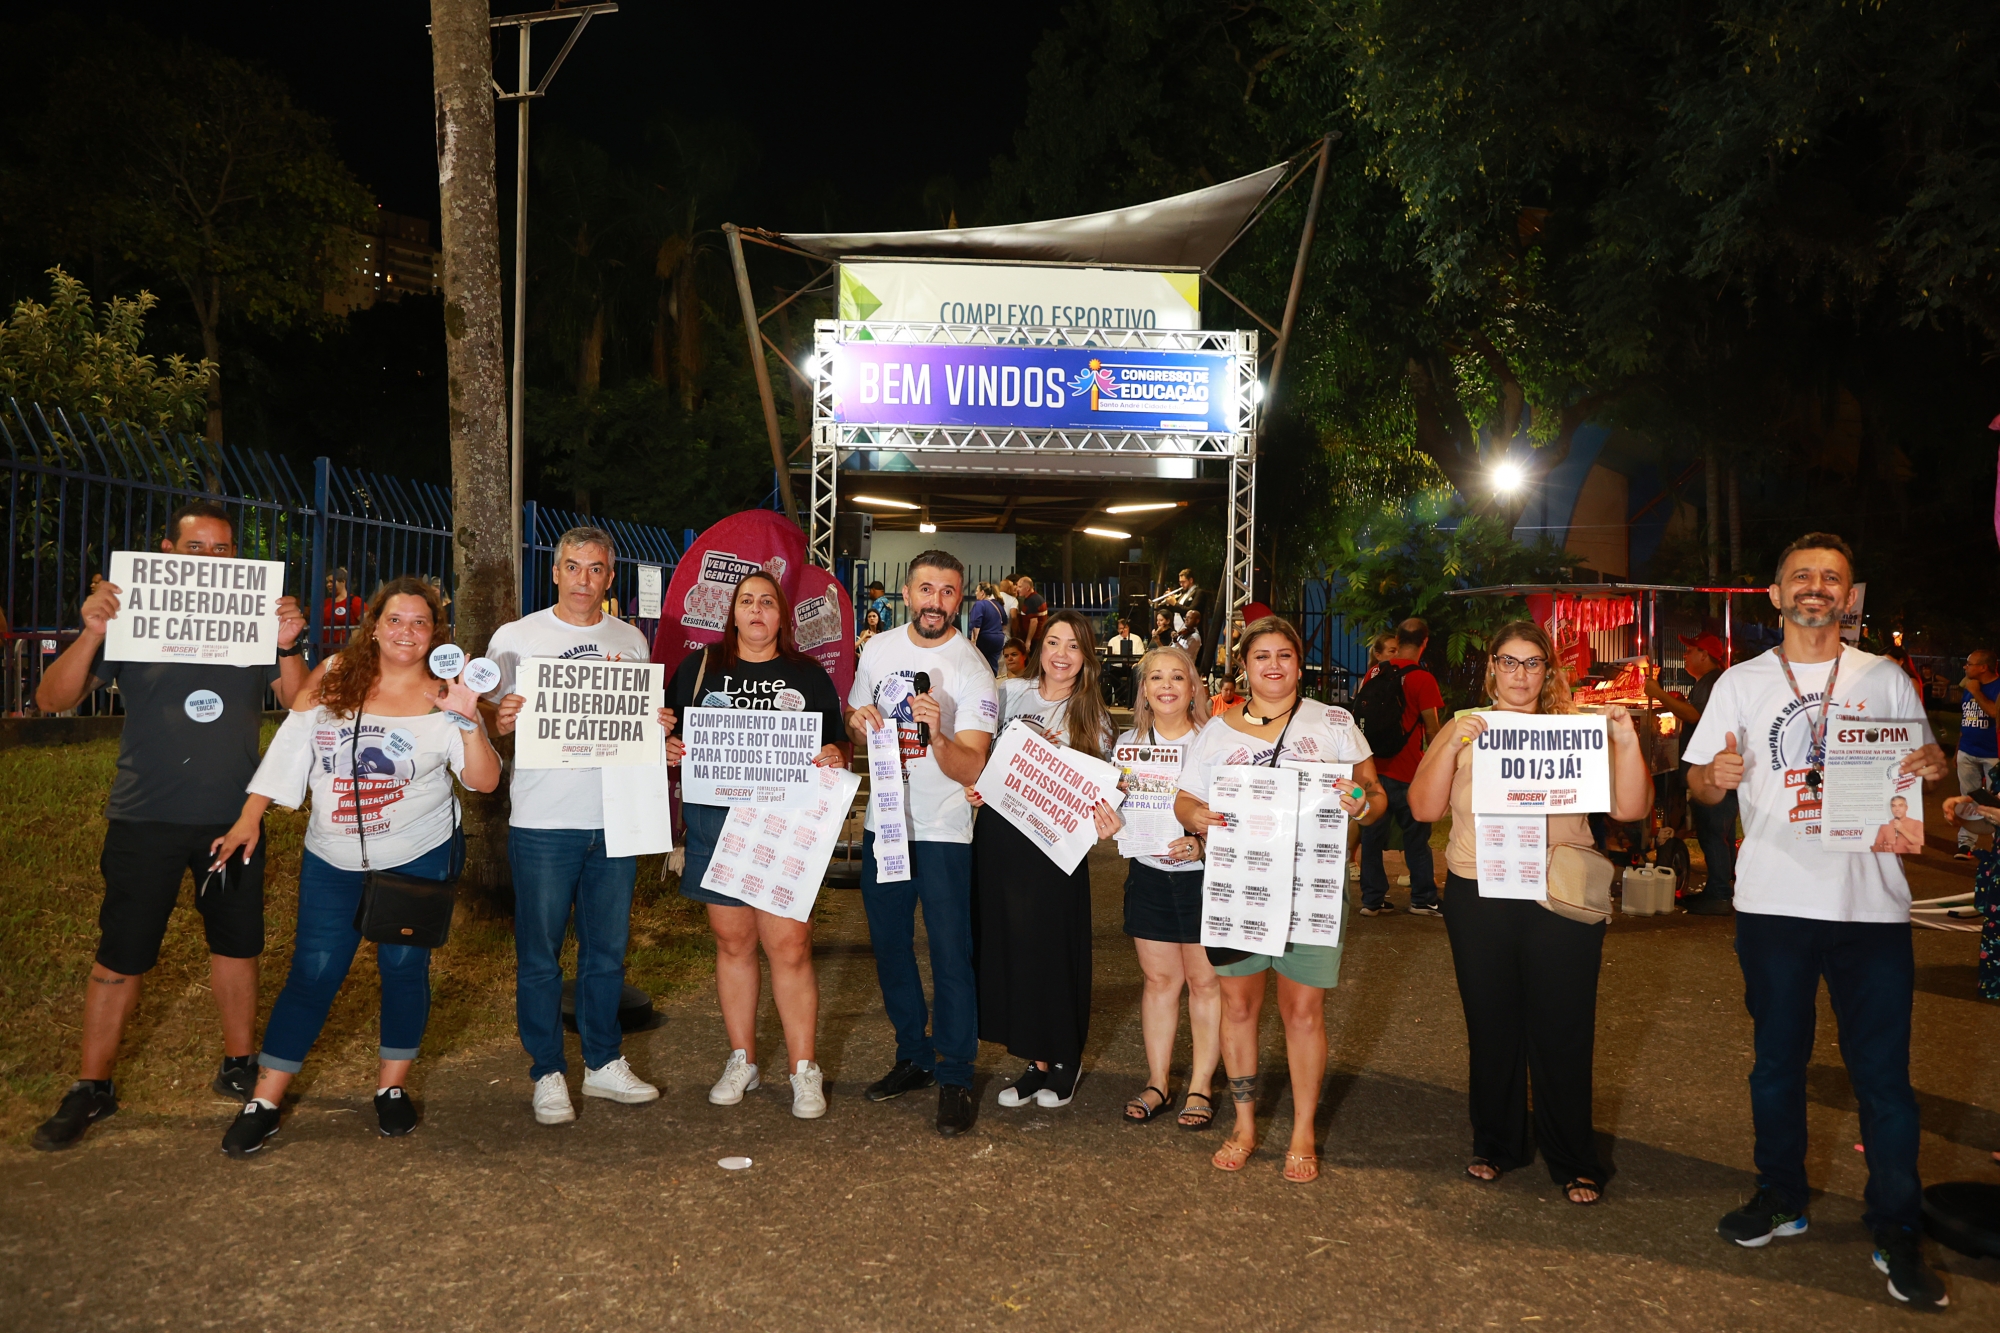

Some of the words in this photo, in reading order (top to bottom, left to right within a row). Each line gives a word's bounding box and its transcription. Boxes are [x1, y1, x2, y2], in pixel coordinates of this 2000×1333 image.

[1052, 305, 1156, 329] ESPORTIVO
[859, 362, 931, 405] BEM
[945, 364, 1065, 408] VINDOS
[1121, 369, 1192, 382] CONGRESSO
[1193, 372, 1209, 383] DE
[1121, 382, 1209, 403] EDUCAÇÃO
[132, 558, 267, 590] RESPEITEM
[705, 570, 739, 583] GENTE!
[708, 559, 727, 569] VEM
[728, 563, 749, 574] COM
[129, 588, 143, 609] A
[150, 589, 266, 616] LIBERDADE
[797, 604, 811, 614] VEM
[133, 616, 159, 638] DE
[166, 614, 259, 642] CÁTEDRA
[683, 617, 720, 629] RESISTÊNCIA,
[538, 664, 650, 692] RESPEITEM
[724, 676, 786, 694] Lute
[535, 692, 546, 712] A
[552, 692, 649, 716] LIBERDADE
[1962, 702, 1981, 710] CARL
[538, 718, 560, 739] DE
[565, 715, 644, 741] CÁTEDRA
[690, 713, 776, 730] CUMPRIMENTO
[781, 717, 797, 731] DA
[800, 718, 817, 732] LEI
[562, 745, 593, 753] SINDSERV
[694, 730, 710, 745] DA
[712, 732, 735, 746] RPS
[738, 733, 745, 746] E
[747, 733, 770, 748] ROT
[772, 733, 814, 749] ONLINE
[1477, 729, 1603, 750] CUMPRIMENTO
[1769, 716, 1786, 771] CAMPANHA
[691, 748, 723, 763] PARA
[724, 748, 763, 764] TODOS
[765, 751, 772, 764] E
[774, 751, 812, 766] TODAS
[1501, 758, 1525, 779] DO
[1529, 758, 1555, 780] 1/3
[1558, 754, 1582, 779] JÁ!
[694, 764, 710, 779] NA
[713, 765, 741, 781] REDE
[744, 767, 808, 783] MUNICIPAL
[1022, 738, 1084, 789] RESPEITEM
[1081, 781, 1100, 800] OS
[715, 788, 754, 796] SINDSERV
[1009, 753, 1092, 819] PROFISSIONAIS
[340, 793, 394, 807] VALRIZAÇÃO
[1004, 773, 1021, 792] DA
[1021, 784, 1078, 833] EDUCAÇÃO
[1507, 793, 1547, 801] SINDSERV
[339, 812, 378, 822] DIRETOS
[1026, 814, 1060, 844] SINDSERV
